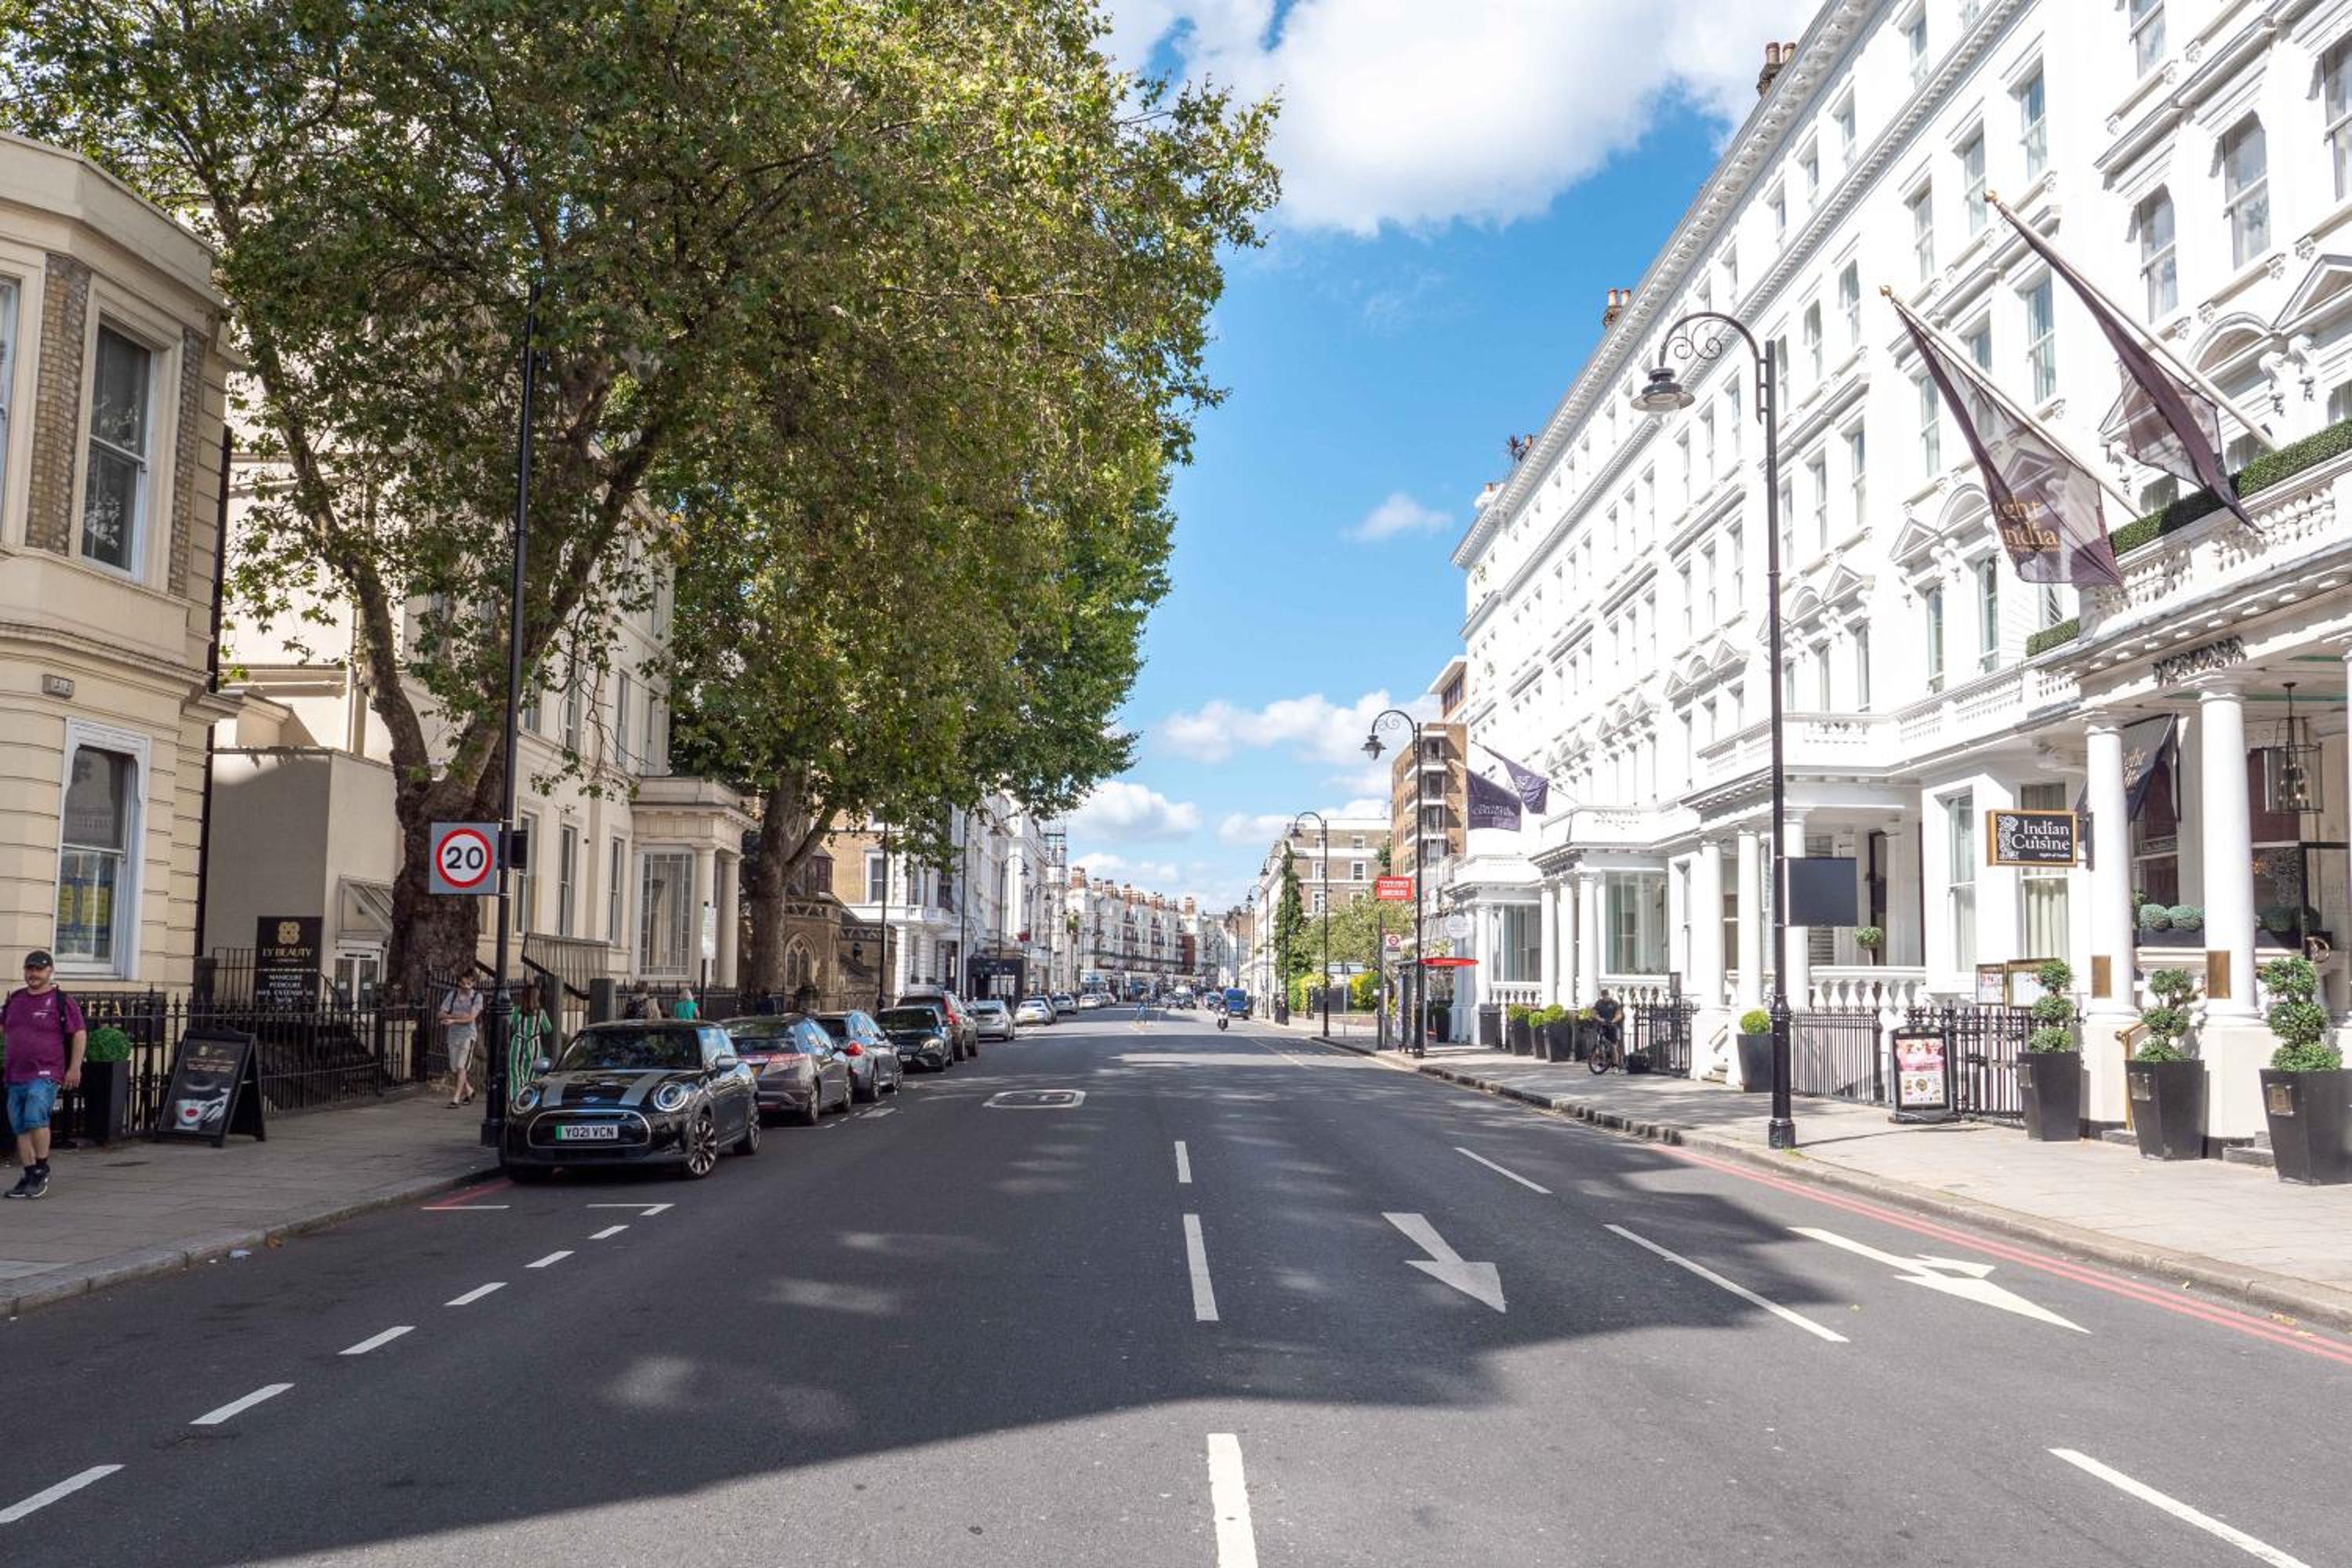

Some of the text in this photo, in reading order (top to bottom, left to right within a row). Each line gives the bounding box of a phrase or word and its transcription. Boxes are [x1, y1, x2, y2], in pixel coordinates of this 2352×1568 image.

[2002, 521, 2059, 546] ndia
[2024, 820, 2070, 836] Indian
[2011, 834, 2071, 851] Cuisine
[446, 846, 484, 870] 20
[276, 947, 314, 957] BEAUTY
